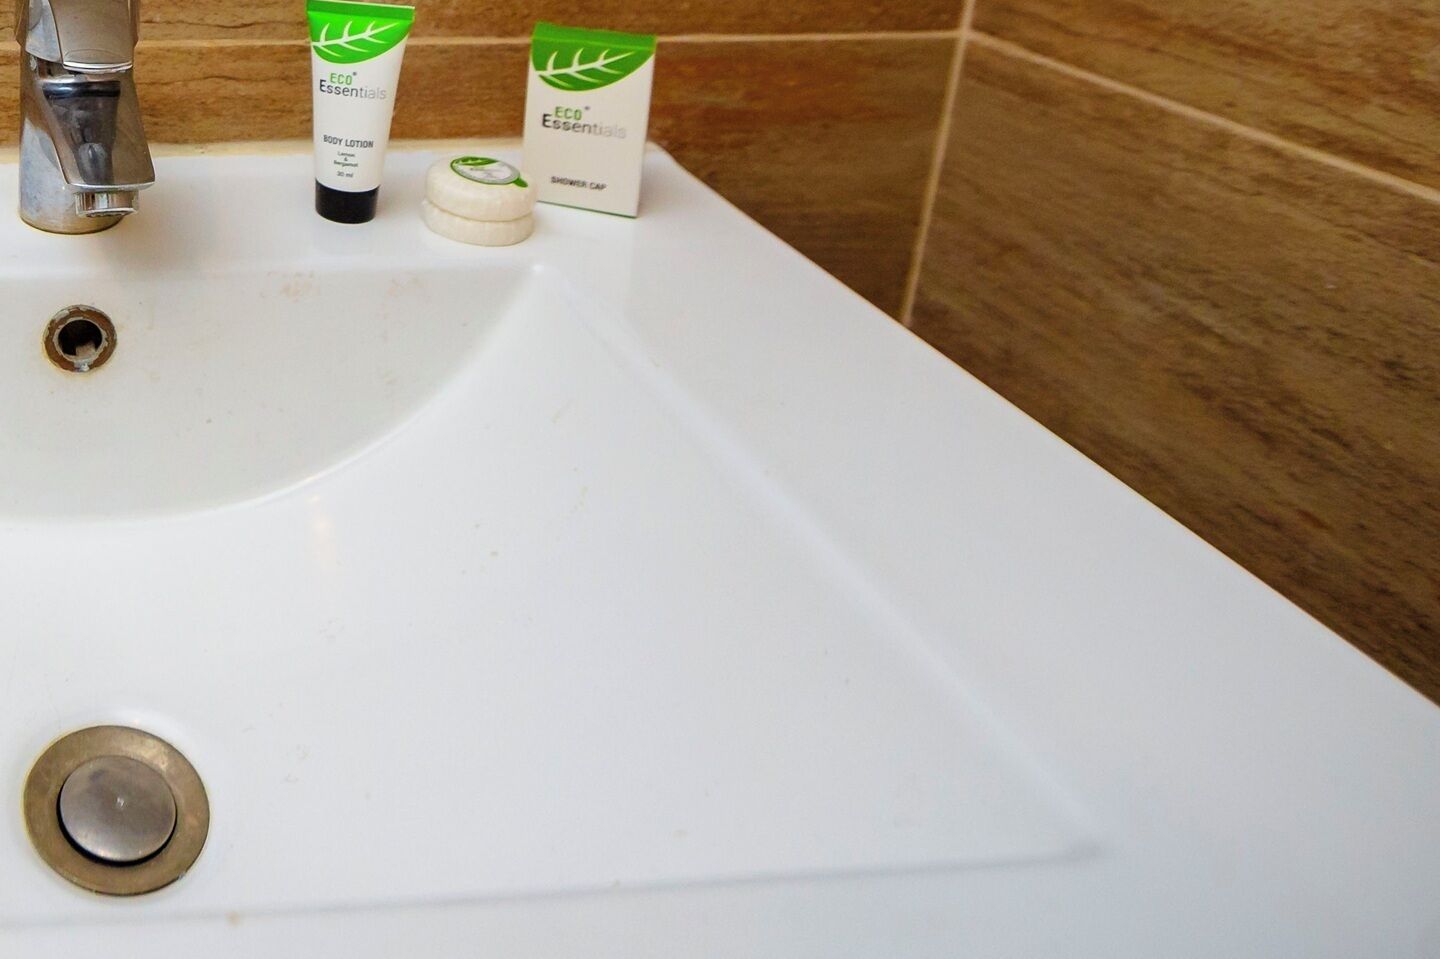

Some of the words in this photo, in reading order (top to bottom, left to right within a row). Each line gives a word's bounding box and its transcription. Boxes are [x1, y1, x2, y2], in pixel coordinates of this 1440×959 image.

[330, 72, 353, 86] ECO
[319, 79, 387, 100] Essentials
[555, 106, 582, 121] ECO
[542, 113, 627, 140] Essentials
[323, 134, 343, 146] BODY
[345, 139, 374, 149] LOTION
[551, 176, 587, 189] SHOWER
[589, 181, 607, 191] CAP
